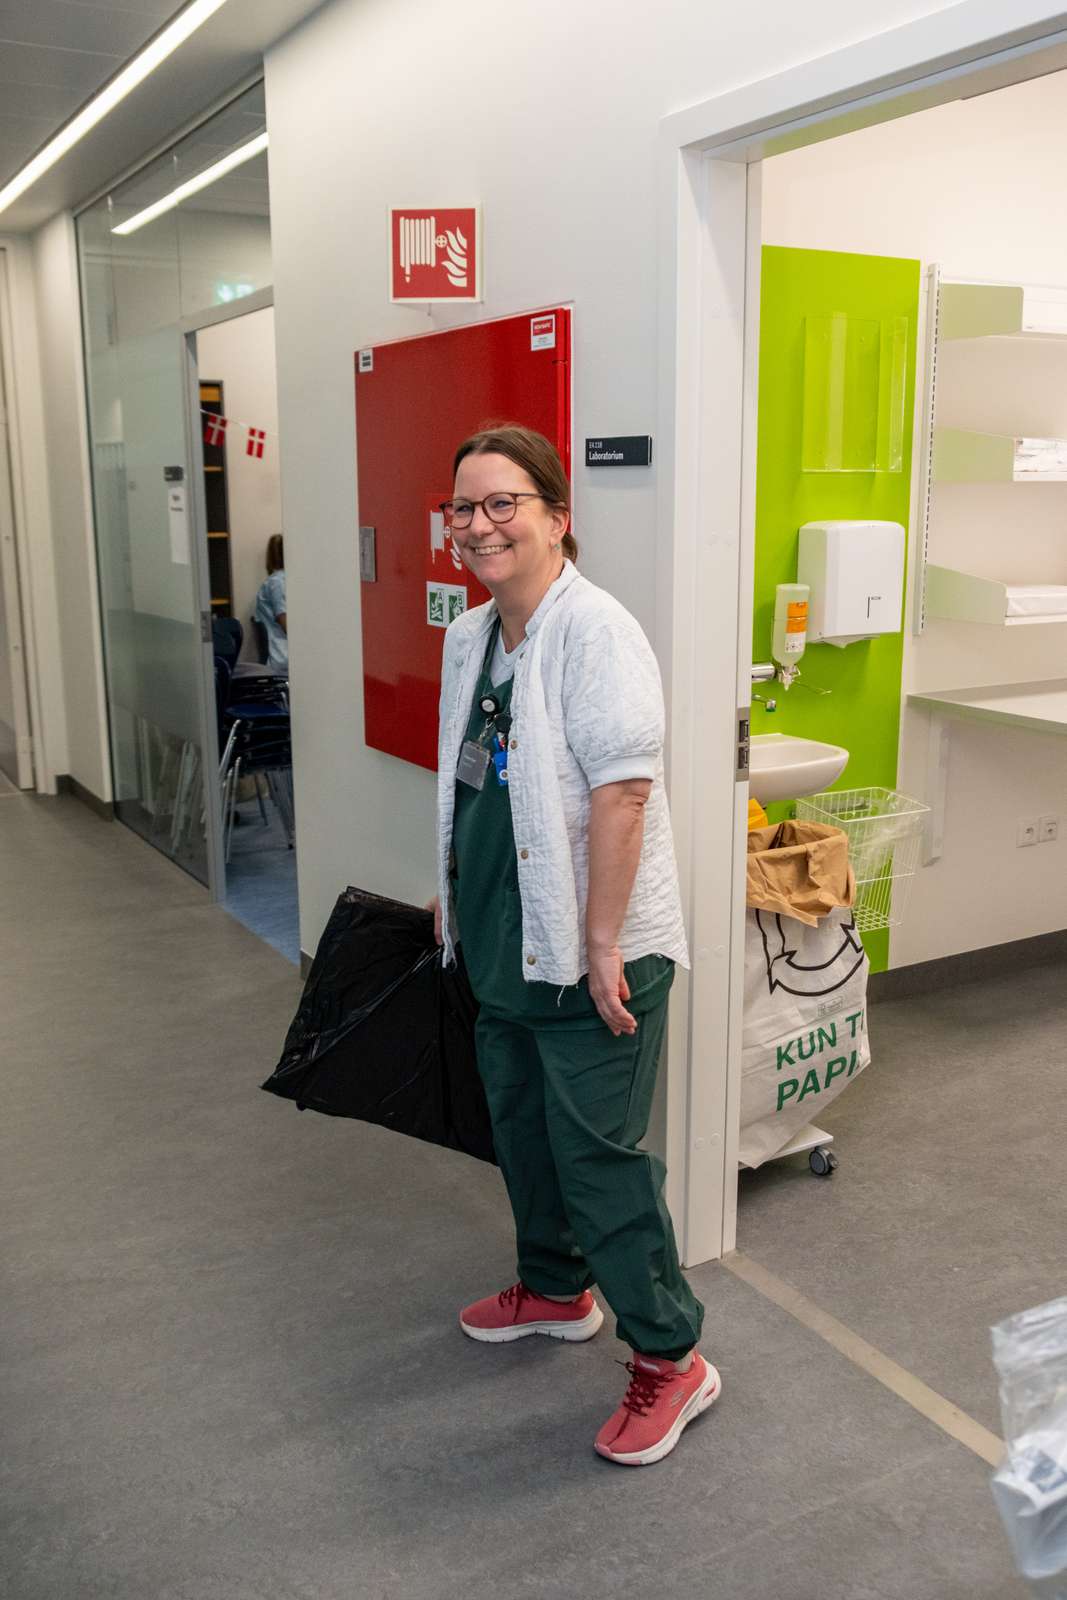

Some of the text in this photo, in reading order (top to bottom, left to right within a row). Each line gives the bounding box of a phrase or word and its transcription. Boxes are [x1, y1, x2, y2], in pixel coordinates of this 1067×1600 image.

[588, 450, 624, 460] Laboratorium
[776, 1022, 838, 1071] KUN
[776, 1050, 860, 1112] PAPI
